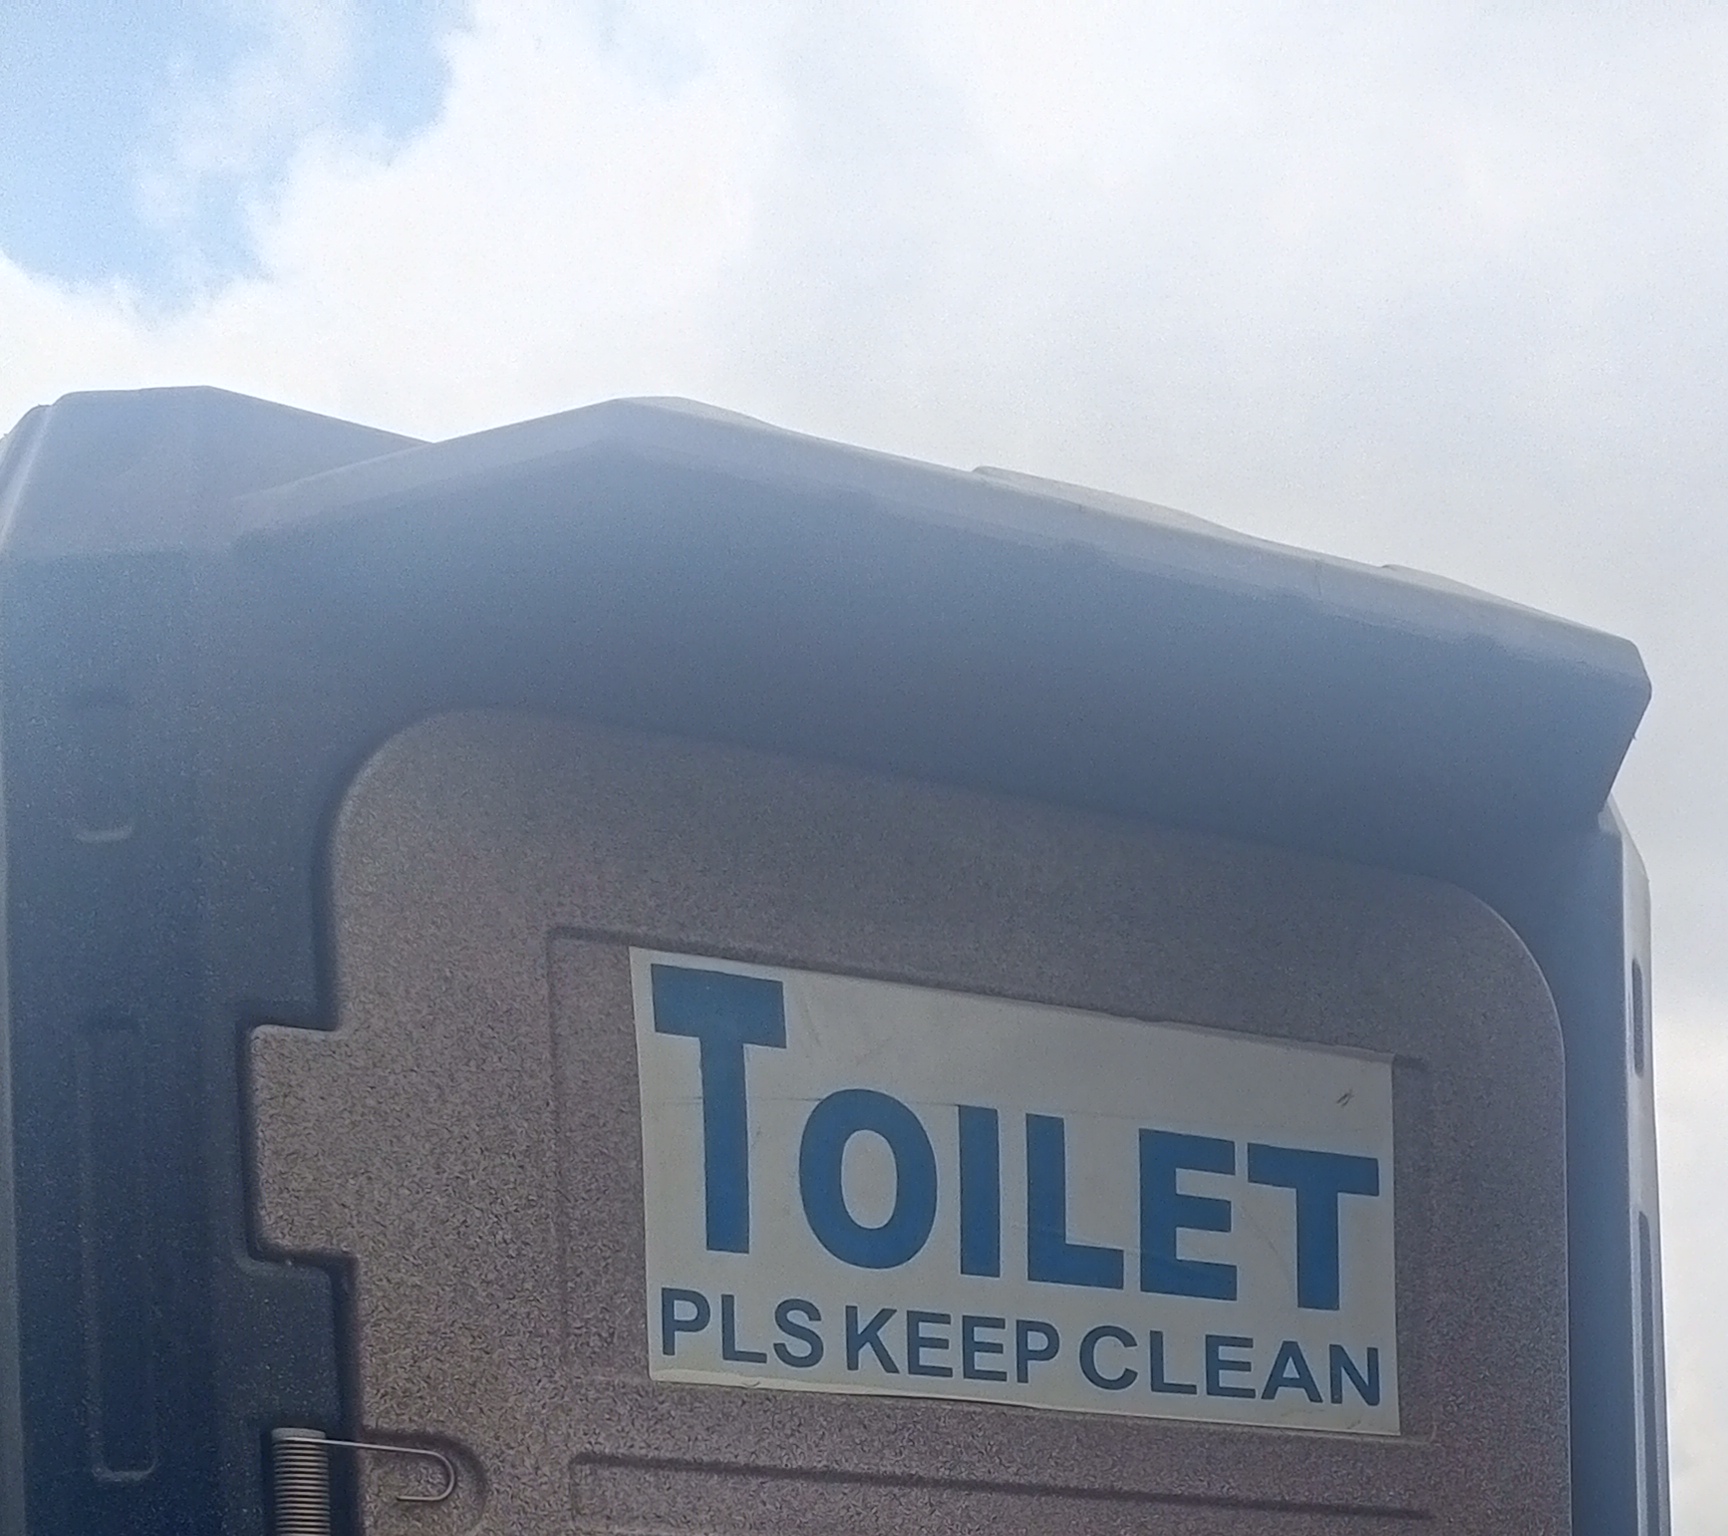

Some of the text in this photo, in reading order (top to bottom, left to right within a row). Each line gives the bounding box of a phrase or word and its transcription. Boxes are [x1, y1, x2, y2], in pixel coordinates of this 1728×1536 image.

[651, 963, 1380, 1310] TOILET
[660, 1287, 1381, 1407] PLS KEEP CLEAN
